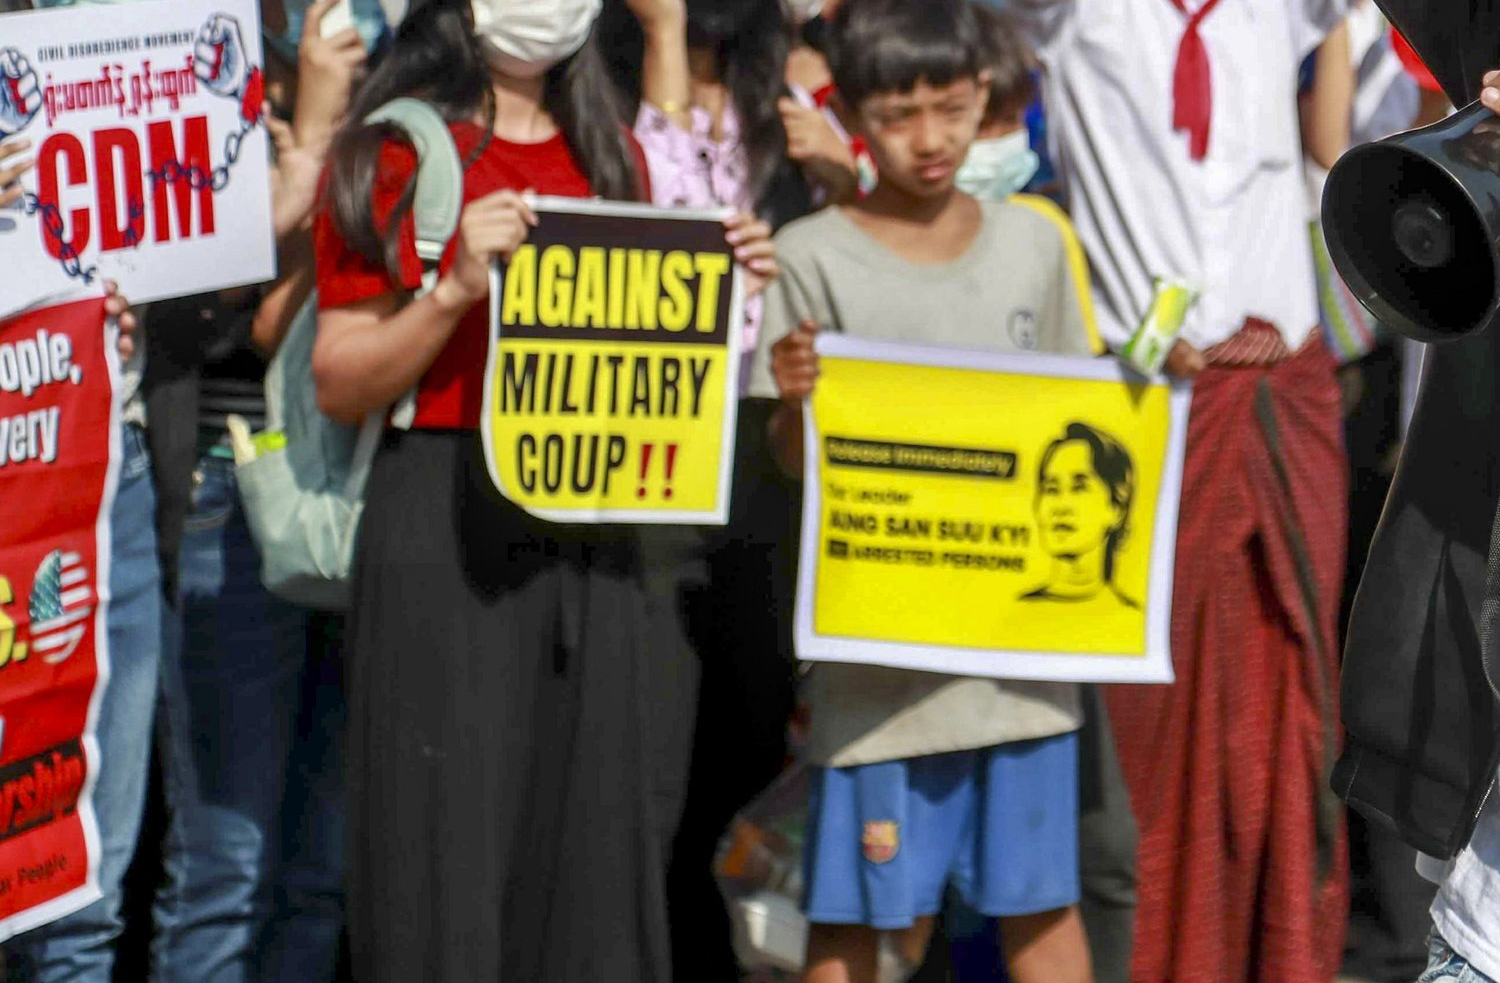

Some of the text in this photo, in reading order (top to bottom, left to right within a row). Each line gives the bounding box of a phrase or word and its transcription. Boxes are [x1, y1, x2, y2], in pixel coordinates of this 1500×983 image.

[37, 116, 216, 260] CDM
[501, 244, 731, 333] AGAINST
[501, 351, 712, 417] MILITARY
[885, 517, 931, 538] SAN
